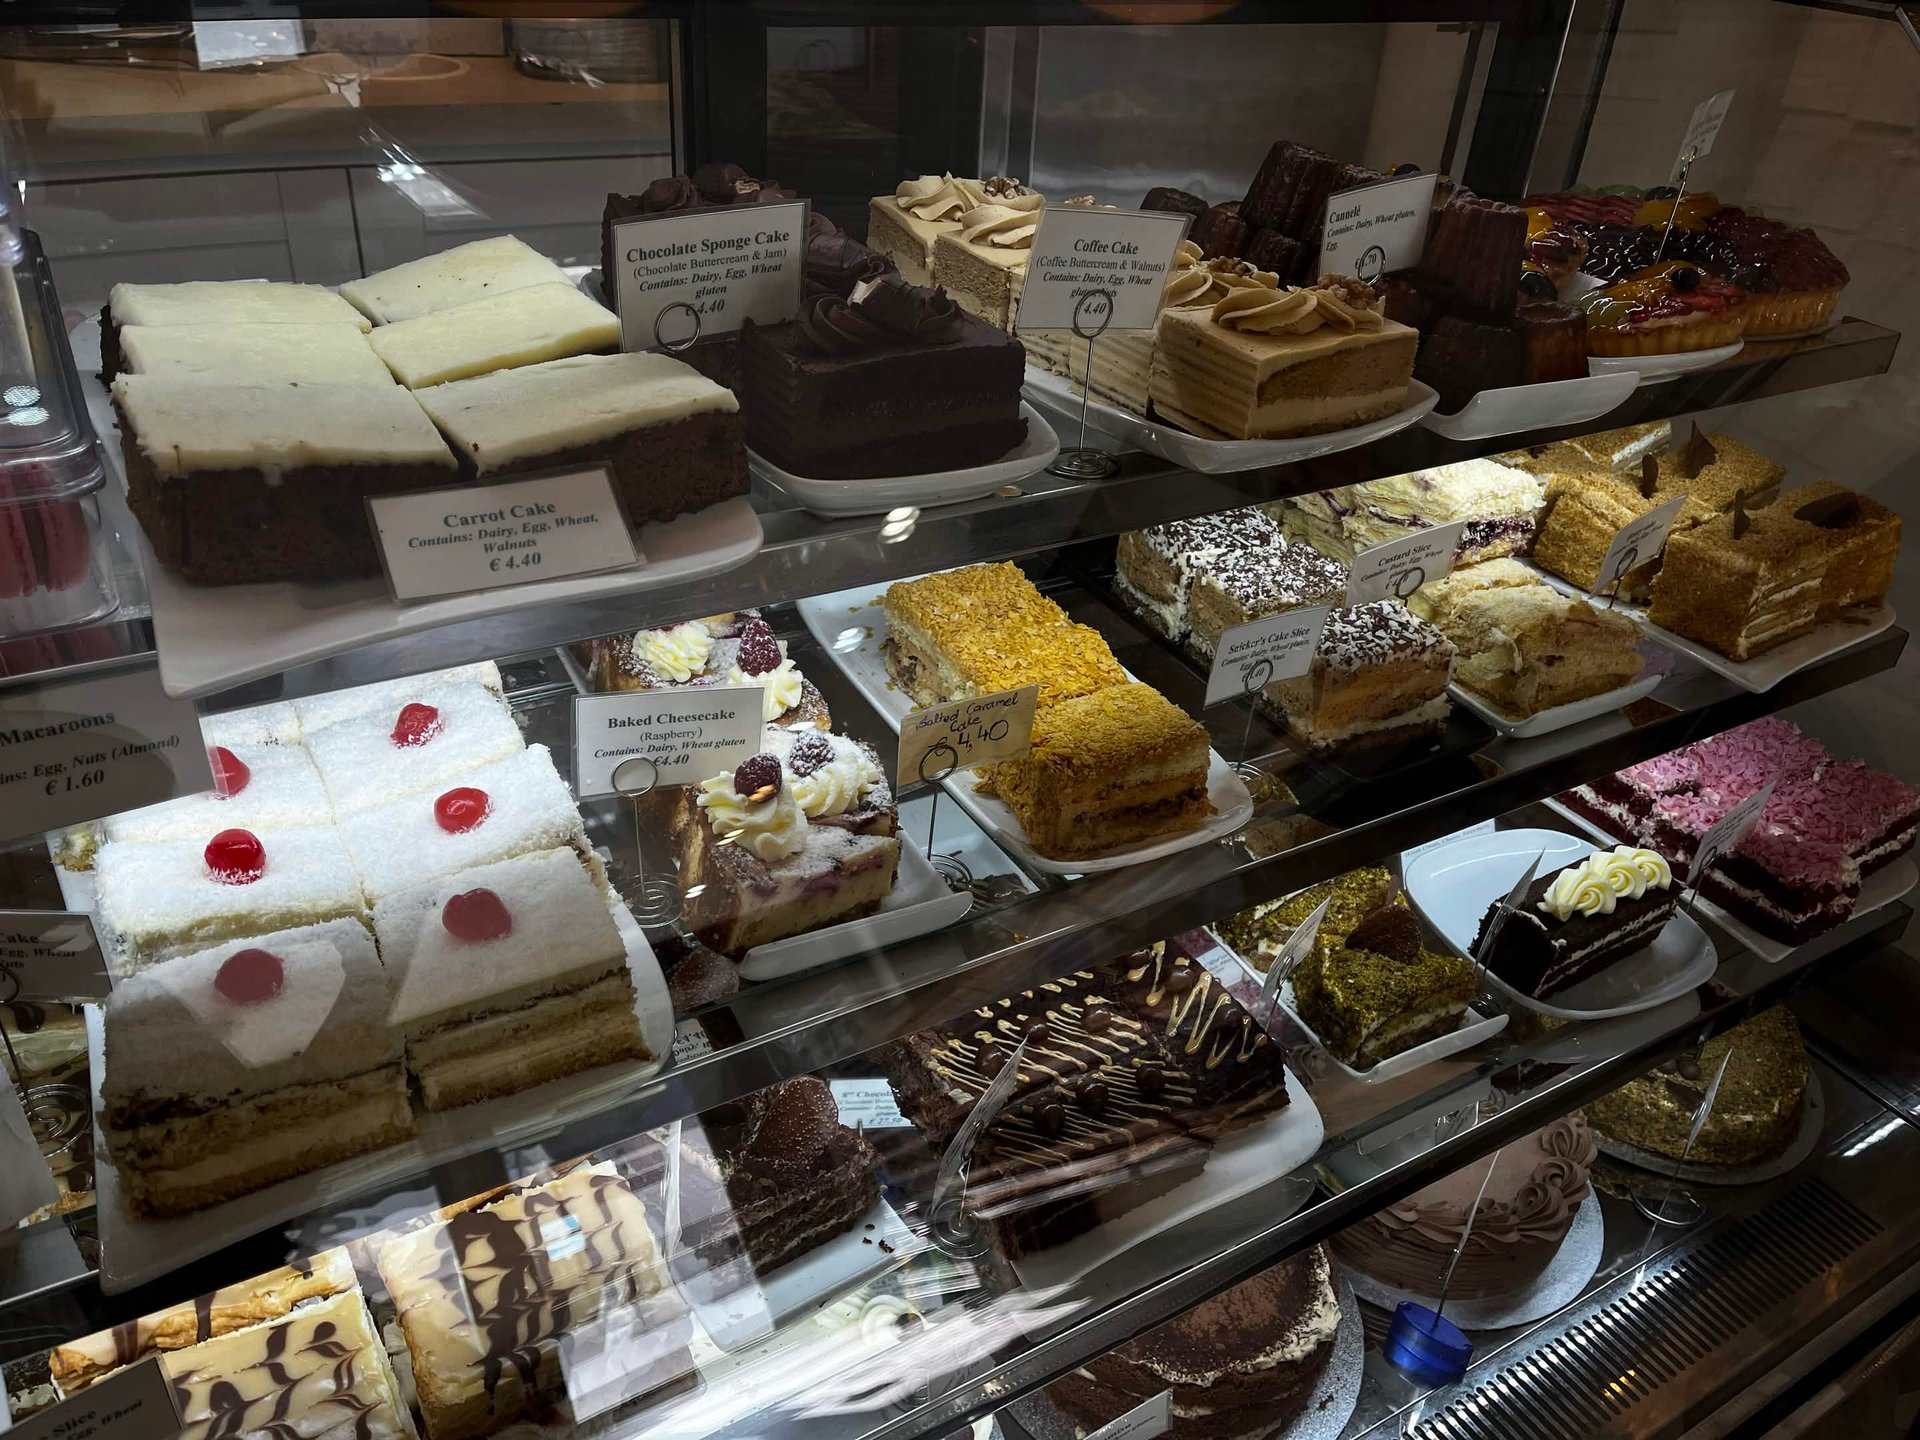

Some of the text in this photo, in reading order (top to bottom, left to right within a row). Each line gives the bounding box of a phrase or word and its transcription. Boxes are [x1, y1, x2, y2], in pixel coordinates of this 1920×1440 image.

[1329, 204, 1361, 224] Cannelé
[1374, 213, 1394, 225] Wheat
[626, 230, 790, 263] Chocolate Sponge Cake
[1074, 238, 1139, 255] Coffee Cake
[633, 248, 787, 280] (Chocolate Buttercream & Jam)
[1036, 256, 1166, 273] (Coffee Buttercream & Walnuts)
[639, 263, 782, 292] Contains: Dairy, Egg, Wheat
[1043, 271, 1153, 285] Contains: Dairy, Egg, Wheat
[695, 285, 727, 300] gluten
[443, 502, 556, 529] Carrot Cake
[408, 513, 599, 549] Contains: Dairy, Egg, Wheat,
[483, 537, 537, 553] Walnuts
[1378, 543, 1432, 567] Custard Slice
[1228, 627, 1311, 655] Snicker's Cake Slice
[607, 709, 735, 729] Baked Cheesecake
[917, 692, 1019, 731] Salted Caramel
[0, 712, 115, 748] Macaroons
[950, 714, 981, 733] Cake
[640, 727, 703, 743] (Raspberry)
[33, 763, 67, 778] Egg,
[72, 753, 106, 768] Nuts
[112, 735, 180, 761] (Almond)
[594, 737, 746, 758] Contains: Dairy, Wheat gluten
